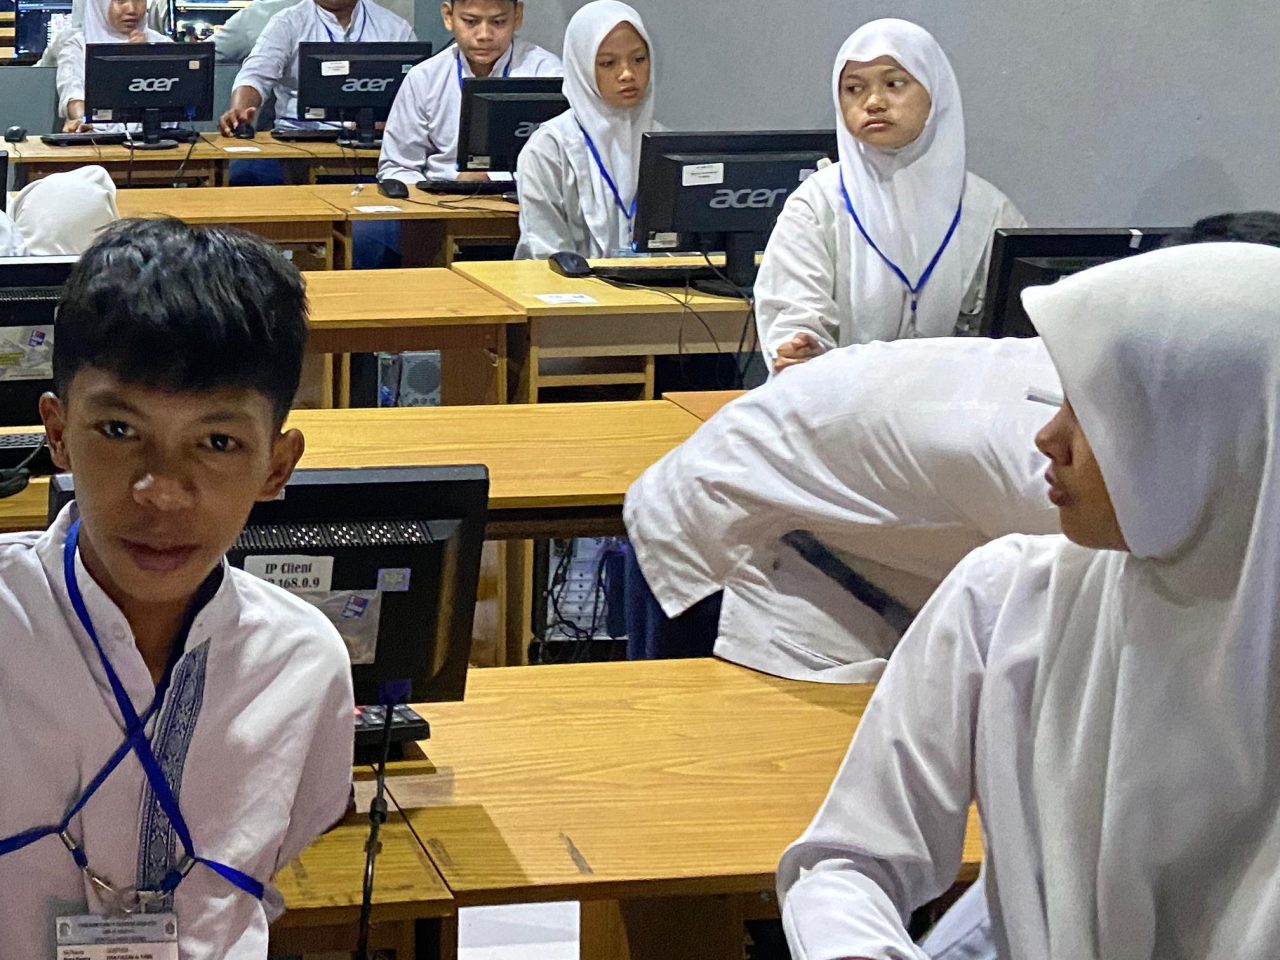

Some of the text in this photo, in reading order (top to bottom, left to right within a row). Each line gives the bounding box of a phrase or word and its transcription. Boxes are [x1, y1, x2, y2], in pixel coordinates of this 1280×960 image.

[128, 77, 180, 92] acer
[341, 78, 395, 92] acer
[709, 188, 787, 209] acer
[265, 562, 313, 574] IP Client
